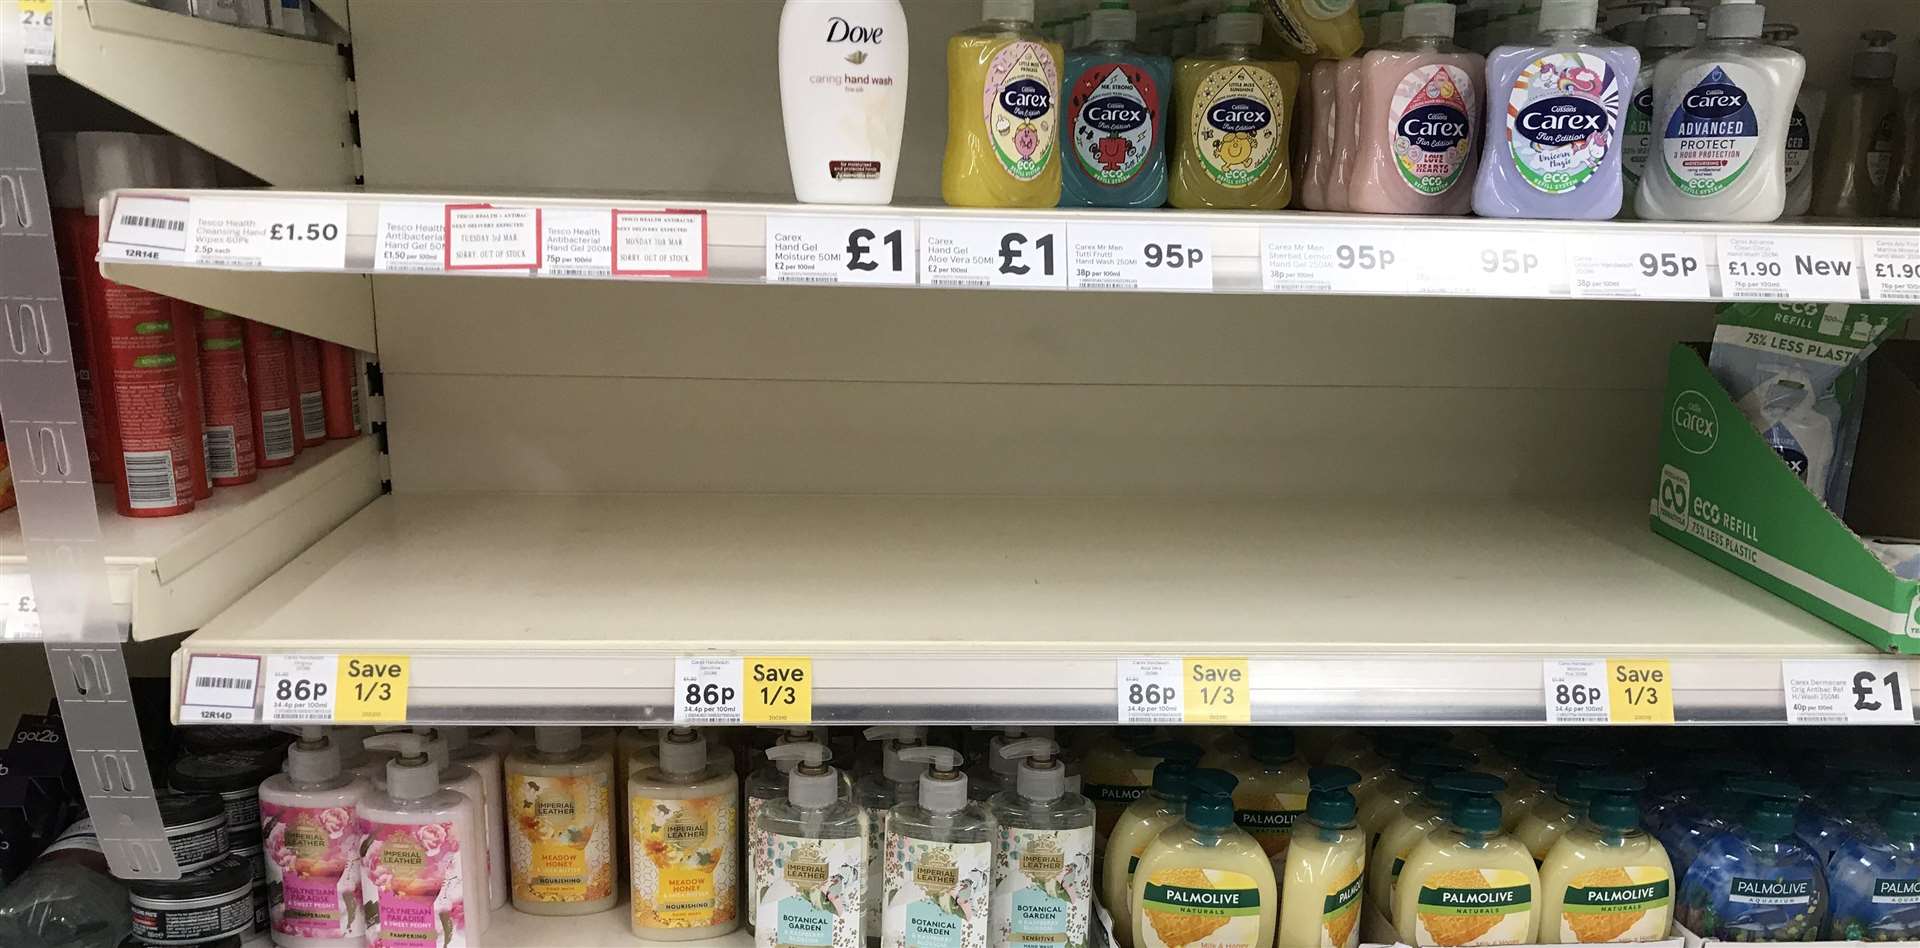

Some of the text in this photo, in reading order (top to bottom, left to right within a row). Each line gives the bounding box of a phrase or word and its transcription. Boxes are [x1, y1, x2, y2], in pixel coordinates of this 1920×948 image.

[826, 17, 883, 44] Dove
[809, 73, 892, 86] caring hand wash
[1005, 90, 1048, 108] Carex
[1686, 94, 1742, 108] Carex
[1552, 104, 1576, 113] Cussons
[1088, 107, 1142, 122] Carex
[1212, 109, 1266, 122] Carex
[1522, 112, 1600, 130] Carex
[1404, 119, 1464, 136] Carex
[1678, 121, 1744, 136] ADVANCED
[1416, 137, 1430, 146] Fun
[1536, 132, 1586, 143] Fun Edition
[1680, 139, 1736, 150] PROTECT
[1424, 154, 1444, 164] LOVE
[1538, 152, 1570, 162] Unicorn
[1699, 150, 1740, 158] PROTECTION
[1017, 160, 1035, 170] eco
[1416, 163, 1449, 174] HEARTS
[1102, 170, 1123, 178] eco
[1224, 170, 1248, 179] eco
[1543, 173, 1570, 183] eco
[1422, 176, 1442, 186] eco
[1688, 178, 1715, 188] eco
[198, 218, 256, 227] Tesco Health
[386, 222, 413, 232] Tesco
[243, 228, 266, 236] Hand
[270, 222, 338, 242] £1.50
[548, 227, 600, 236] Tesco Health
[196, 236, 224, 245] Wipes
[460, 234, 518, 242] TUESDAY MAR
[547, 236, 600, 244] Antibacterial
[626, 238, 652, 246] MONDAY
[774, 232, 802, 242] Carex
[928, 236, 954, 246] Carex
[194, 246, 214, 254] 2.5p
[384, 241, 427, 250] Hand Gel
[546, 244, 585, 252] Hand Gel
[774, 242, 818, 252] Hand Gel
[846, 228, 903, 272] £1
[928, 246, 968, 255] Hand Gel
[125, 248, 160, 260] 12R14E
[384, 251, 406, 260] £1.50
[480, 250, 527, 258] OUT STOCK
[774, 252, 816, 262] Moisture
[998, 232, 1054, 276] £1
[1091, 250, 1113, 258] Frutti
[1144, 243, 1204, 269] 95p
[1336, 244, 1396, 270] 95p
[546, 255, 560, 264] 75p
[928, 255, 972, 264] Aloe Vera
[1076, 258, 1115, 266] Hand Wash
[1480, 249, 1538, 274] 95p
[774, 262, 785, 271] £2
[928, 264, 938, 274] £2
[1640, 252, 1697, 278] 95p
[1728, 261, 1782, 276] £1.90
[1795, 254, 1852, 276] New
[1076, 269, 1090, 278] 38p
[1270, 270, 1284, 279] 38p
[1774, 312, 1814, 329] REFILL
[1745, 332, 1804, 354] 75% LESS
[1675, 406, 1713, 438] Carex
[1694, 496, 1720, 524] eco
[1723, 512, 1758, 542] REFILL
[1692, 520, 1758, 564] 75% LESS PLASTIC
[348, 660, 402, 678] Save
[753, 664, 804, 682] Save
[1192, 664, 1242, 682] Save
[1616, 665, 1664, 683] Save
[276, 679, 328, 701] 86p
[354, 682, 392, 702] 1/3
[686, 684, 734, 705] 86p
[1128, 684, 1176, 704] 86p
[1556, 684, 1601, 705] 86p
[1852, 670, 1902, 711] £1
[760, 686, 796, 706] 1/3
[1200, 686, 1235, 706] 1/3
[1624, 686, 1658, 706] 1/3
[1793, 704, 1806, 712] 40p
[200, 711, 232, 720] 12R14D
[17, 729, 60, 743] got2b
[667, 824, 704, 832] IMPERIAL
[383, 850, 420, 858] IMPERIAL
[384, 856, 422, 865] LEATHER
[1022, 856, 1060, 864] IMPERIAL
[786, 864, 825, 874] IMPERIAL
[916, 868, 954, 877] IMPERIAL
[786, 871, 826, 880] LEATHER
[916, 874, 955, 884] LEATHER
[668, 878, 705, 886] MEADOW
[286, 887, 335, 896] POLYNESIAN
[1738, 882, 1808, 894] PALMOLIVE
[1166, 890, 1240, 904] PALMOLIVE
[1442, 891, 1514, 903] PALMOLIVE
[1588, 887, 1654, 901] PALMOLIVE
[381, 906, 432, 916] POLYNESIAN
[666, 902, 708, 910] NOURISHING
[1017, 905, 1062, 913] BOTANICAL
[1180, 907, 1226, 915] NATURALS
[386, 914, 426, 922] PARADISE
[783, 914, 828, 925] BOTANICAL
[1022, 912, 1056, 920] GARDEN
[788, 922, 822, 932] GARDEN
[912, 918, 956, 929] BOTANICAL
[390, 932, 428, 940] PAMPERING
[916, 926, 950, 936] GARDEN
